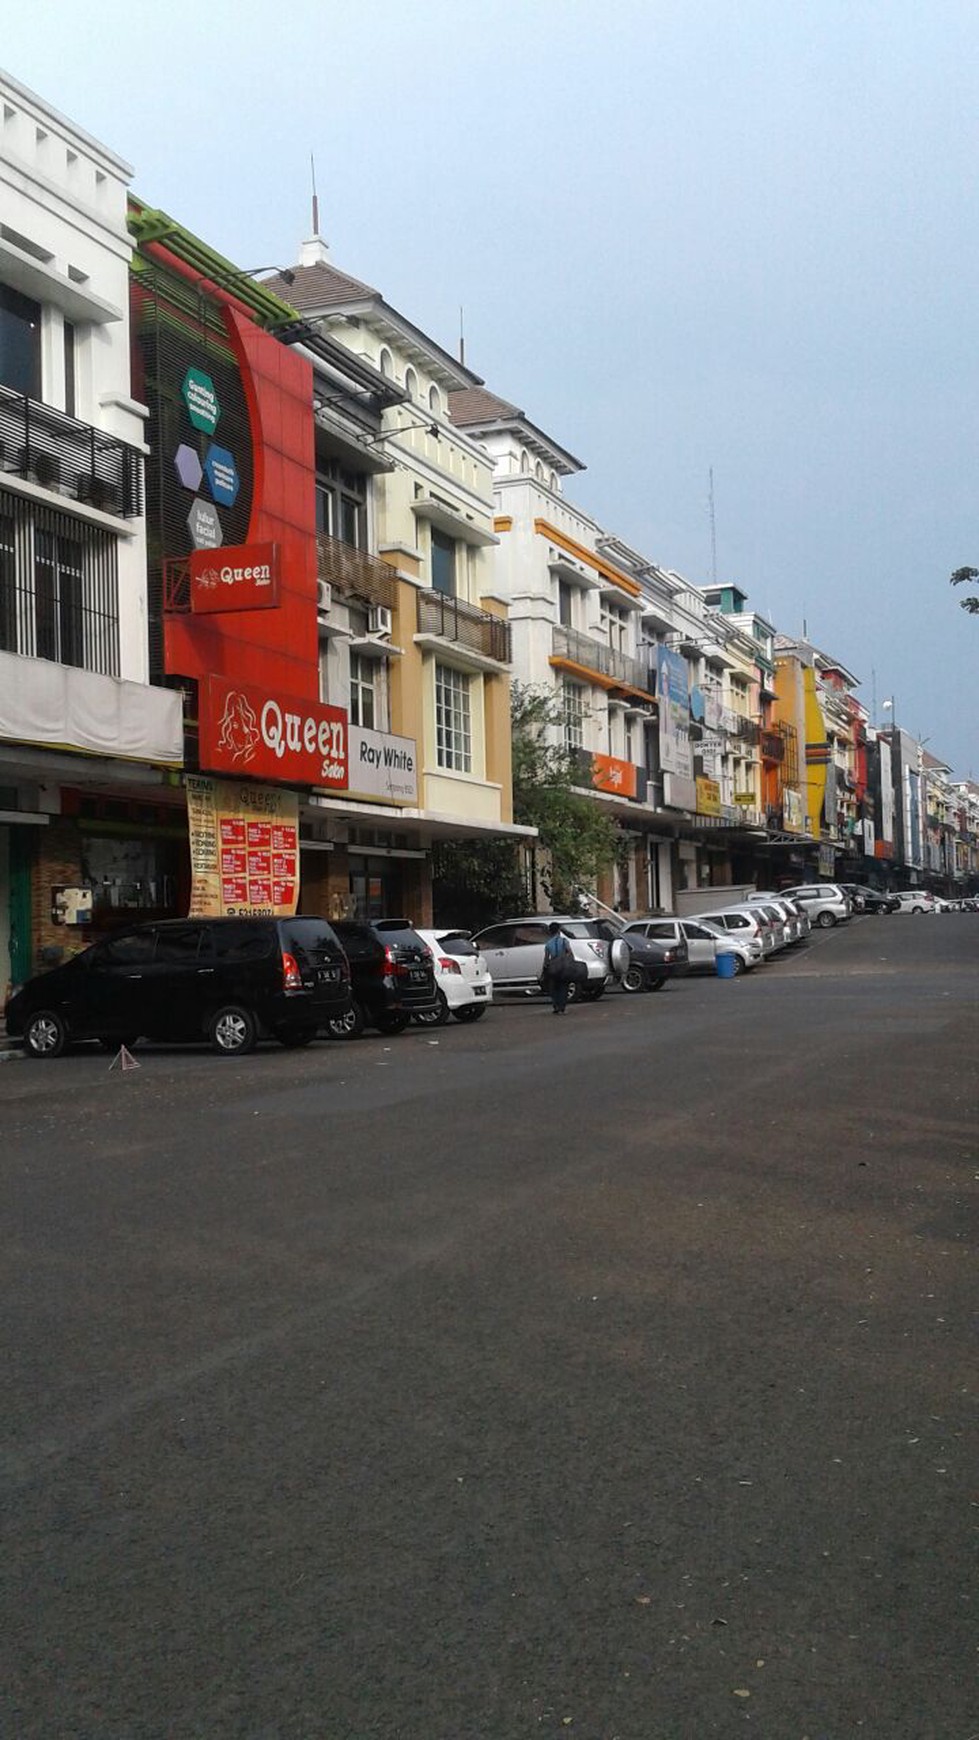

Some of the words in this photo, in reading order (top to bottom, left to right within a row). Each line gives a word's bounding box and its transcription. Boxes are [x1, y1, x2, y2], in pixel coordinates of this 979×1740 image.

[220, 564, 271, 585] Queen
[260, 699, 345, 760] Queen
[359, 740, 382, 770] Ray
[383, 746, 413, 771] White
[321, 759, 345, 780] Salon
